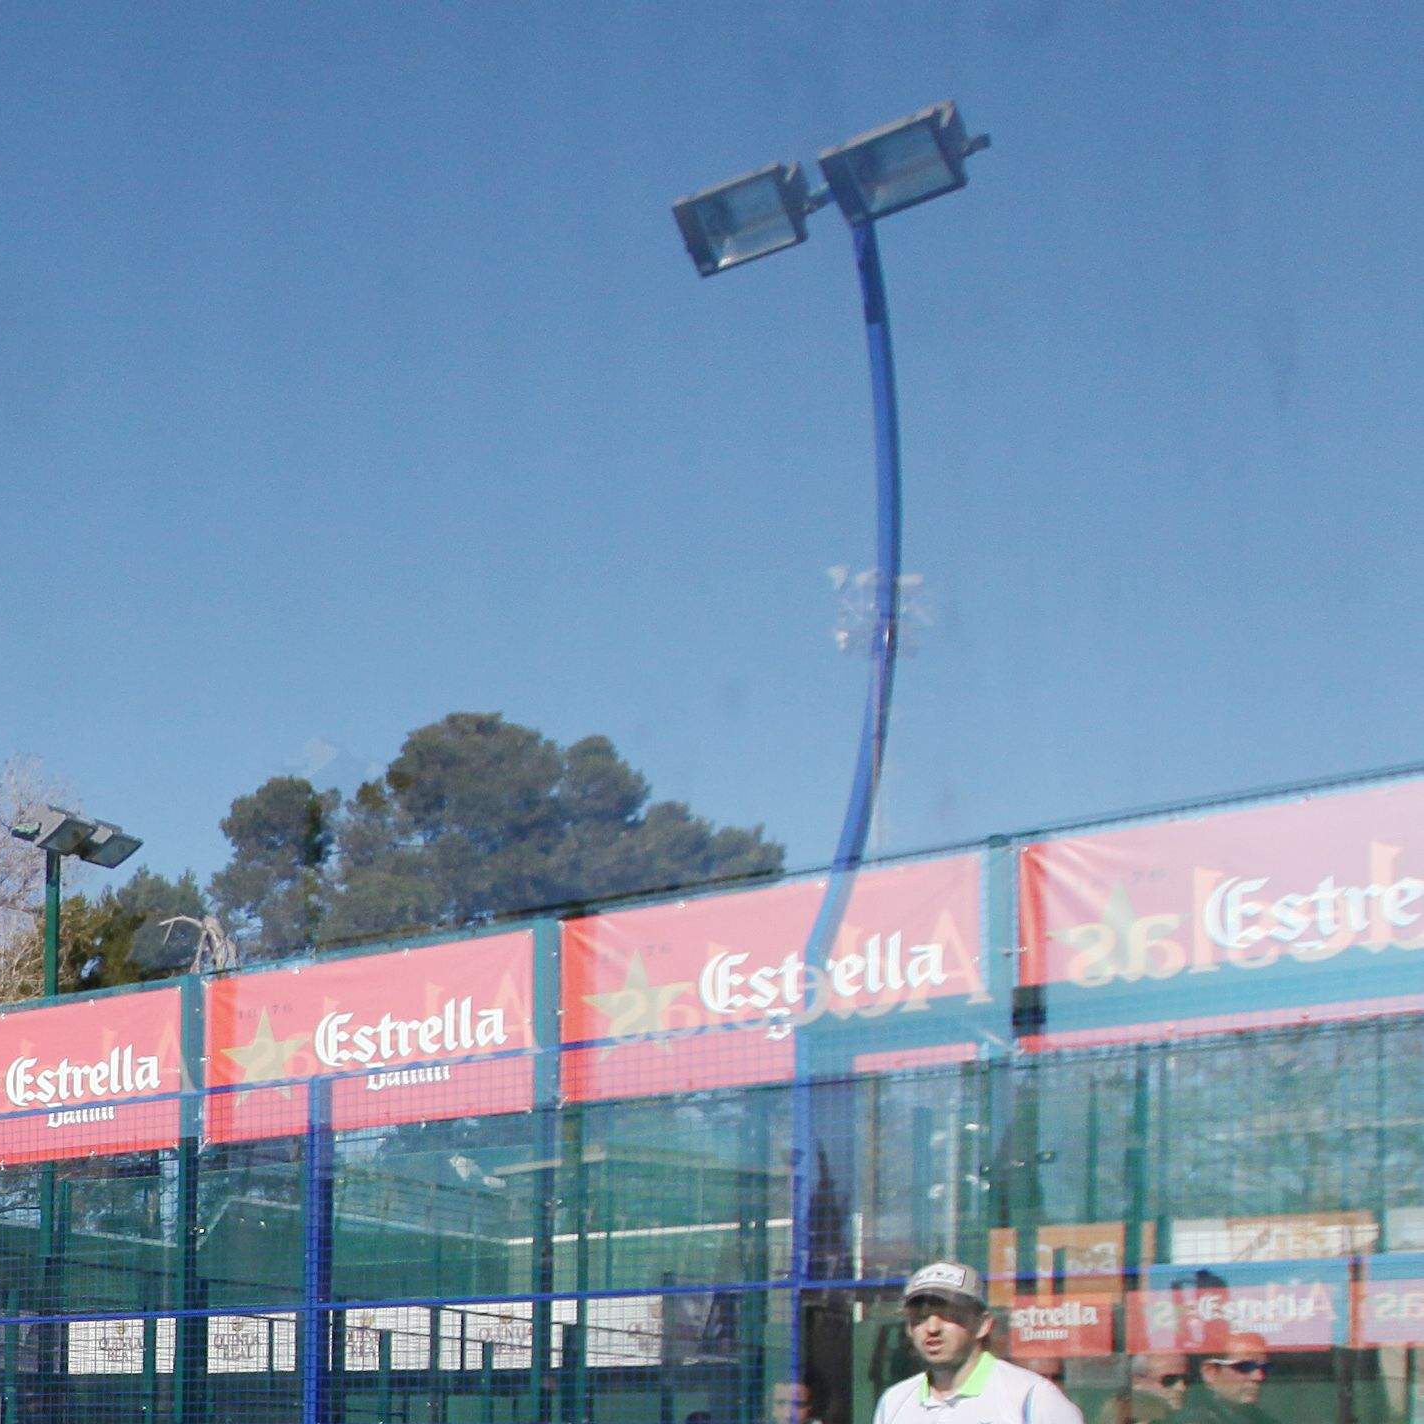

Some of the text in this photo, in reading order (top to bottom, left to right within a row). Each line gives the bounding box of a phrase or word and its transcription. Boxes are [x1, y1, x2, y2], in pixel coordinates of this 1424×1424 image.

[700, 930, 949, 1014] Estella
[315, 996, 507, 1068] Estrella
[5, 1044, 161, 1107] Estrella
[1010, 1300, 1099, 1329] strella
